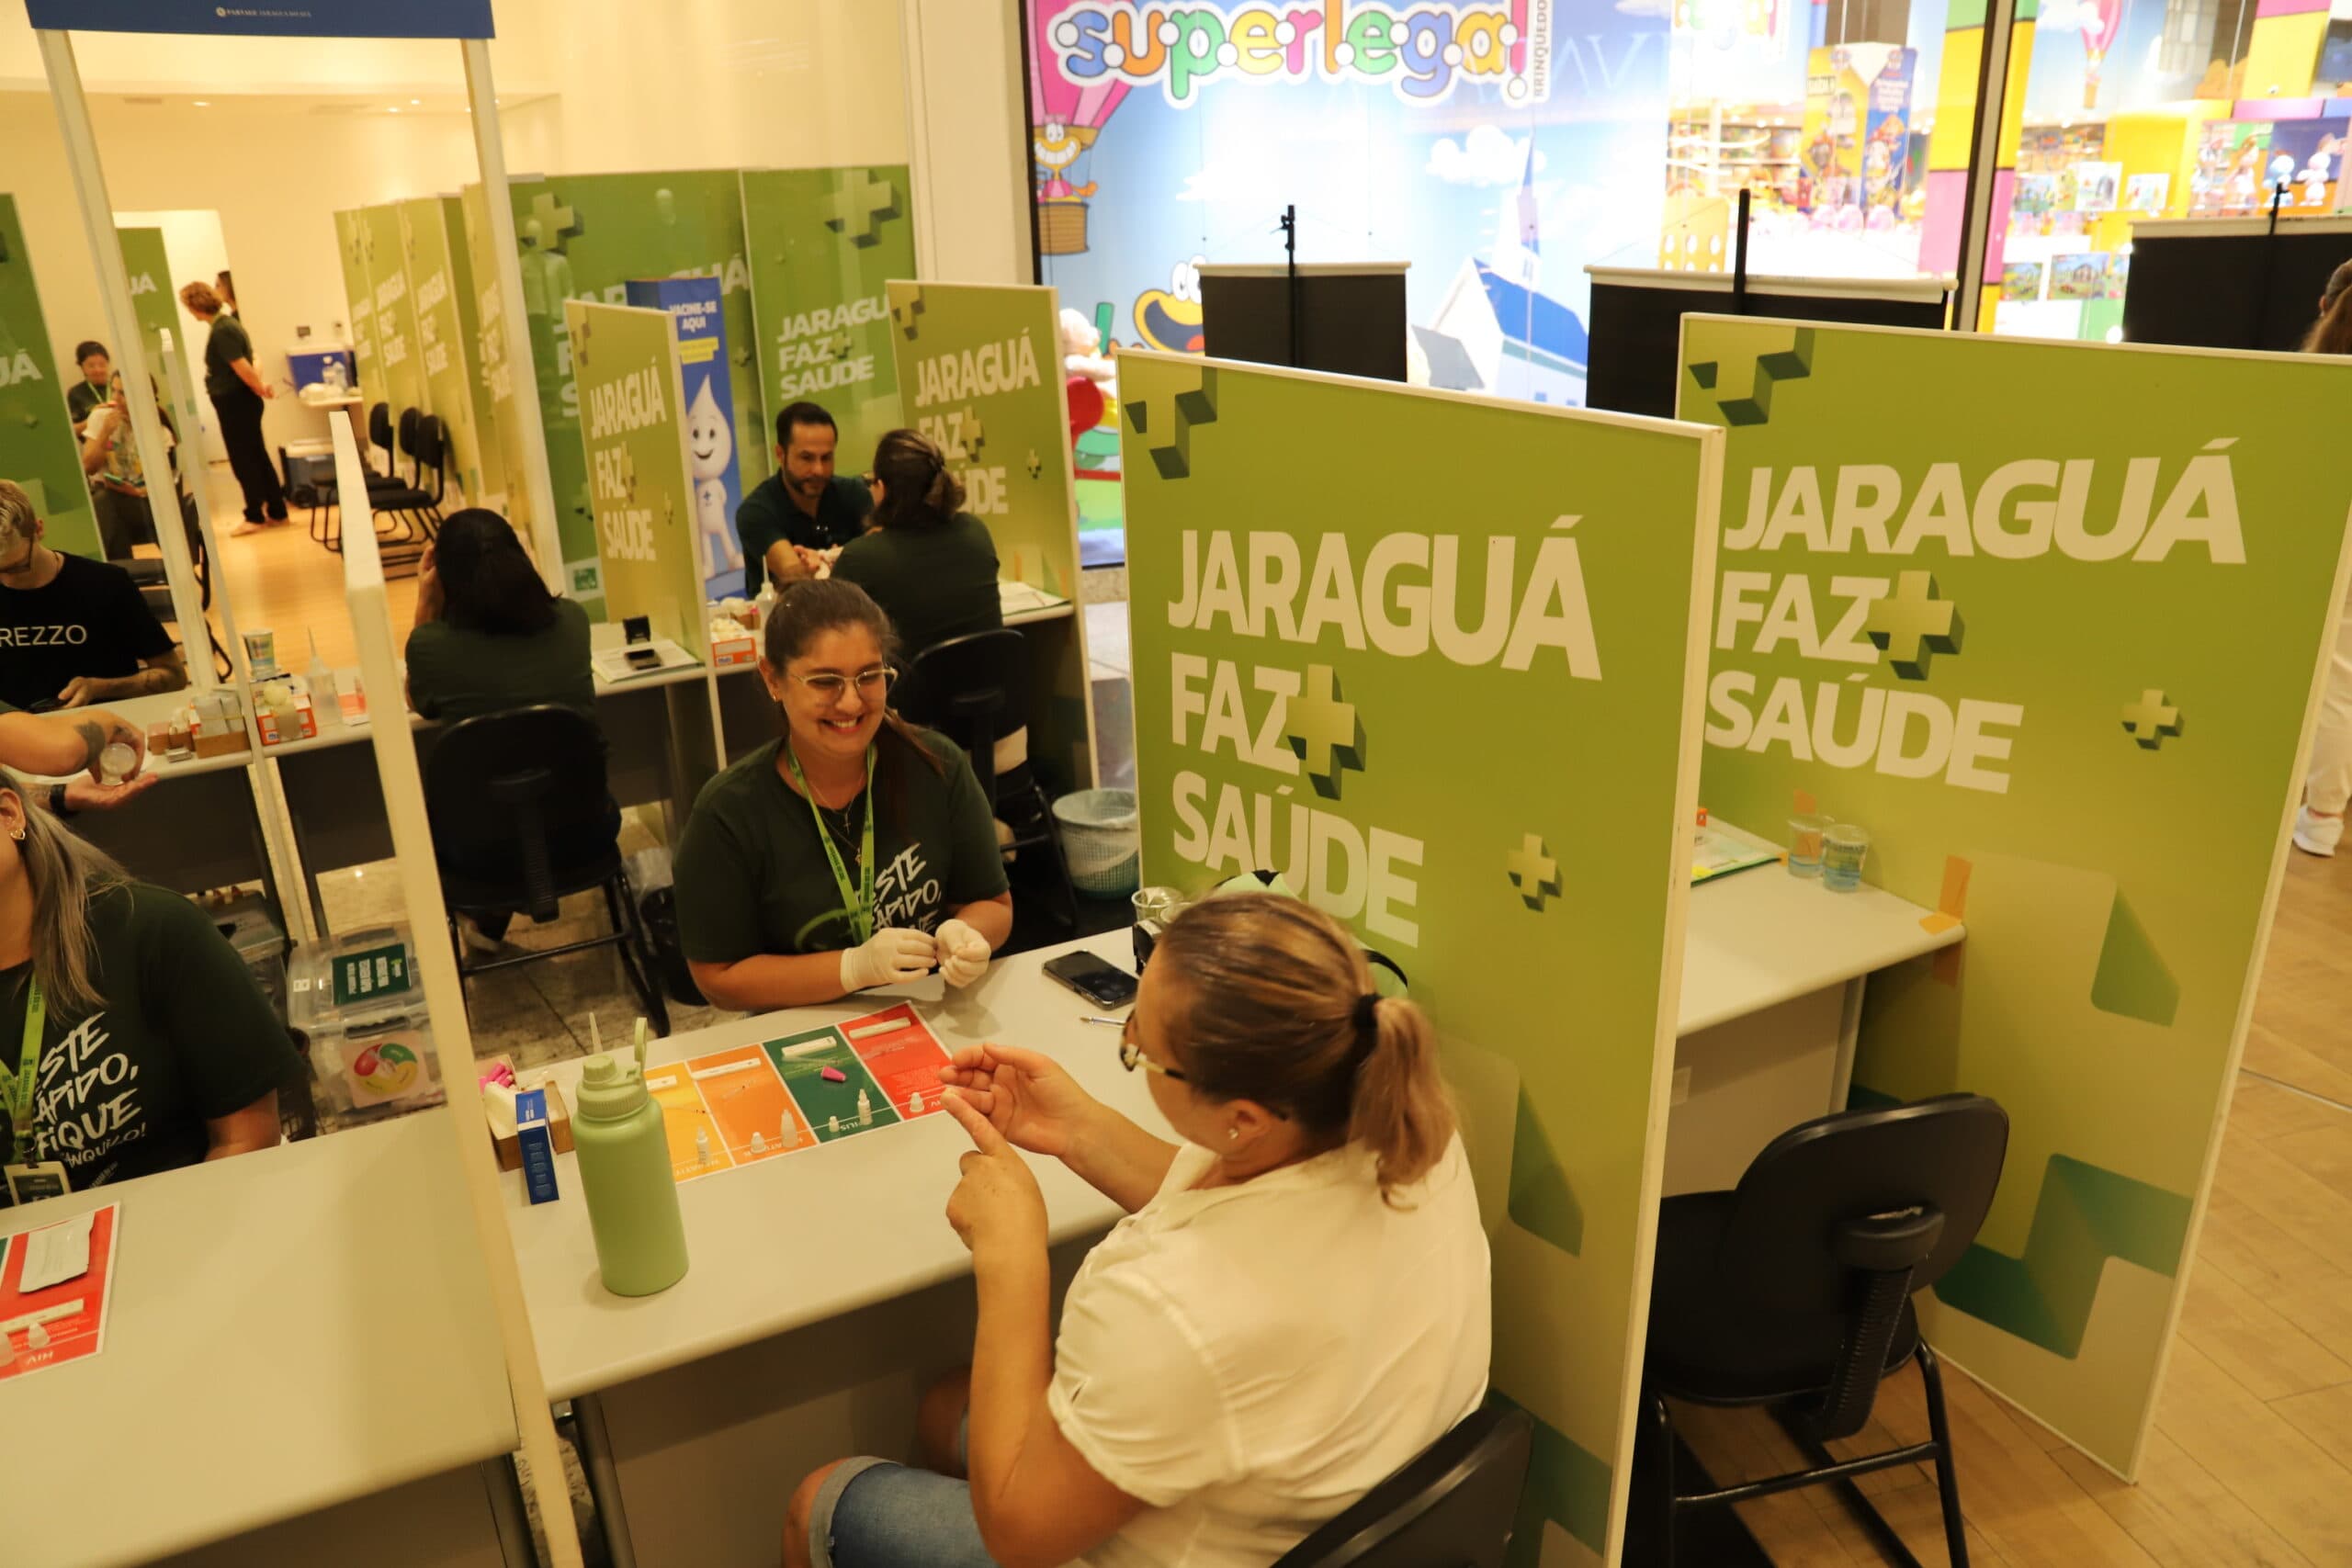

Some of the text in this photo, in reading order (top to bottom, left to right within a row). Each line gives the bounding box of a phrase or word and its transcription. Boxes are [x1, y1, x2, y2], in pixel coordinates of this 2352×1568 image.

[682, 316, 707, 333] AQUI
[777, 293, 890, 343] JARAGU
[590, 356, 667, 439] JARAGUÁ
[915, 327, 1041, 407] JARAGUÁ
[603, 502, 657, 561] SAÚDE
[1724, 437, 2247, 564] JARAGUÁ
[1168, 514, 1602, 681] JARAGUÁ
[1704, 671, 2025, 794] SAÚDE
[1172, 771, 1424, 948] SAÚDE
